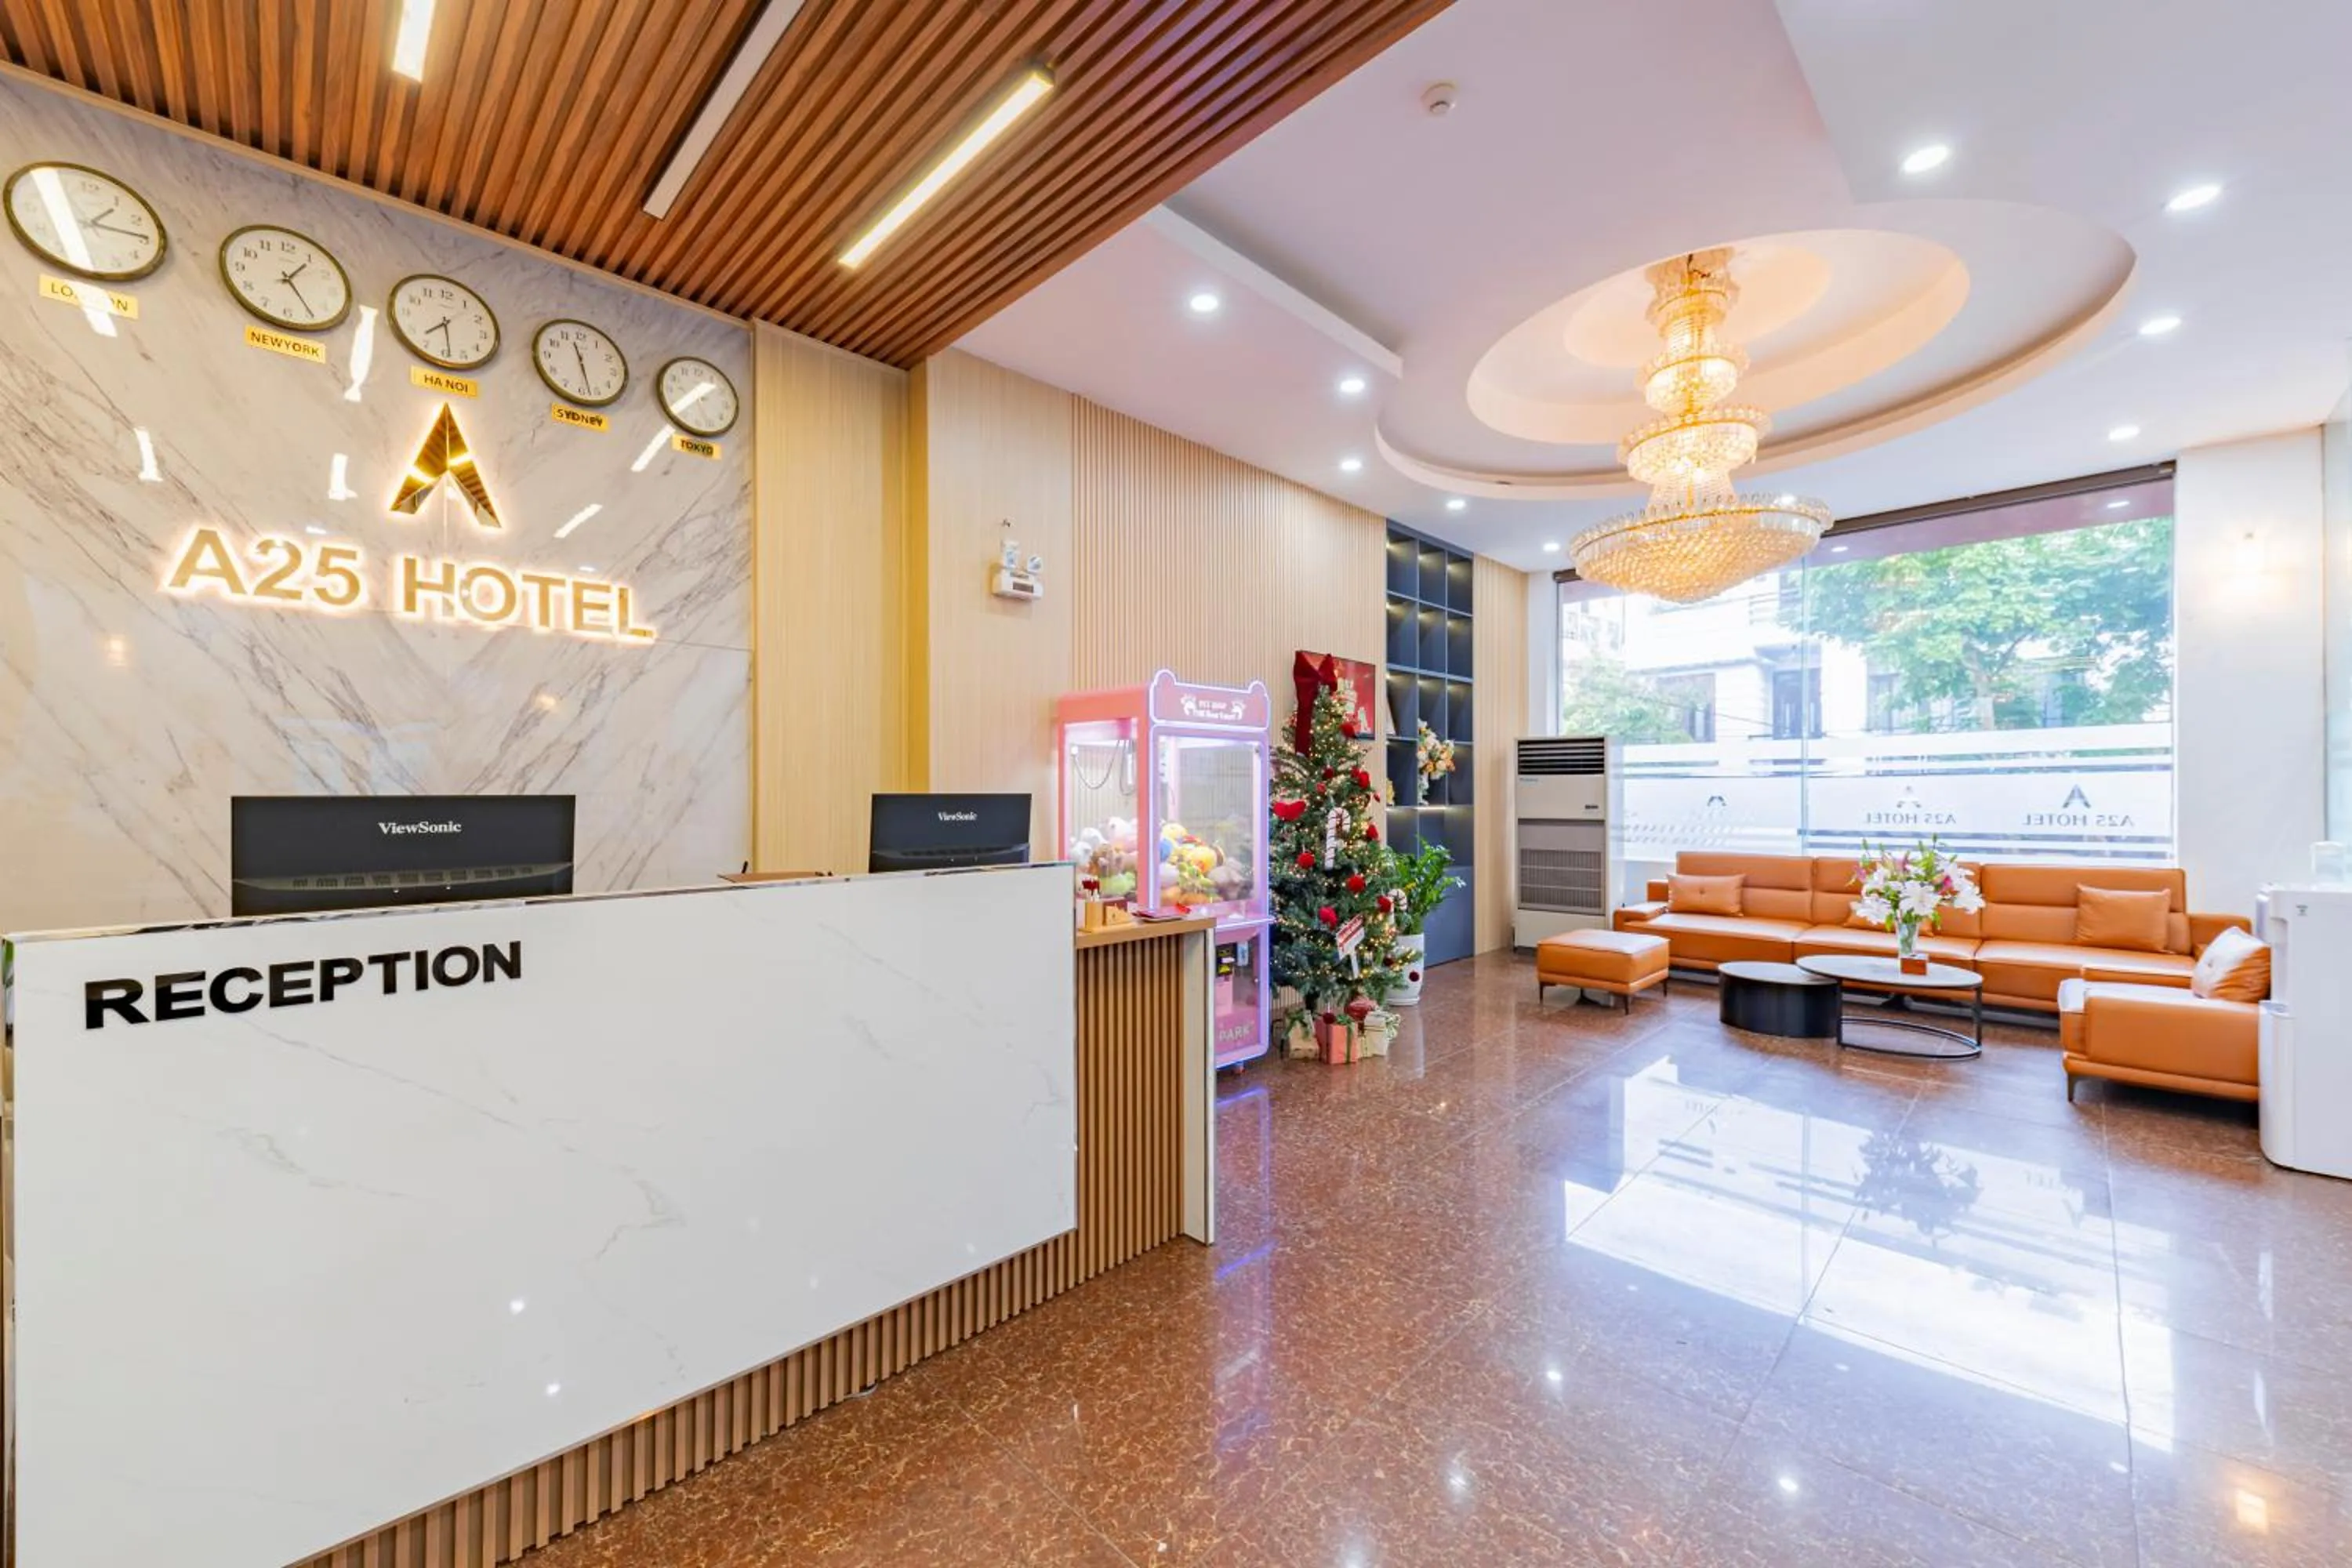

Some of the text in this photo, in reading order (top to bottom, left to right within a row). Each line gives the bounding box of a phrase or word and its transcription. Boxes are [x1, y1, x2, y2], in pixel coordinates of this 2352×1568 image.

[260, 240, 270, 252] 11
[281, 241, 296, 255] 12
[244, 247, 258, 260] 10
[423, 288, 432, 298] 11
[441, 289, 454, 300] 12
[251, 332, 319, 357] NEWYORK
[557, 408, 603, 427] SYDNEY
[681, 439, 713, 456] TOKYO
[169, 528, 654, 638] A25 HOTEL
[938, 811, 978, 821] ViewSonic
[378, 821, 462, 834] ViewSonic
[85, 941, 521, 1029] RECEPTION
